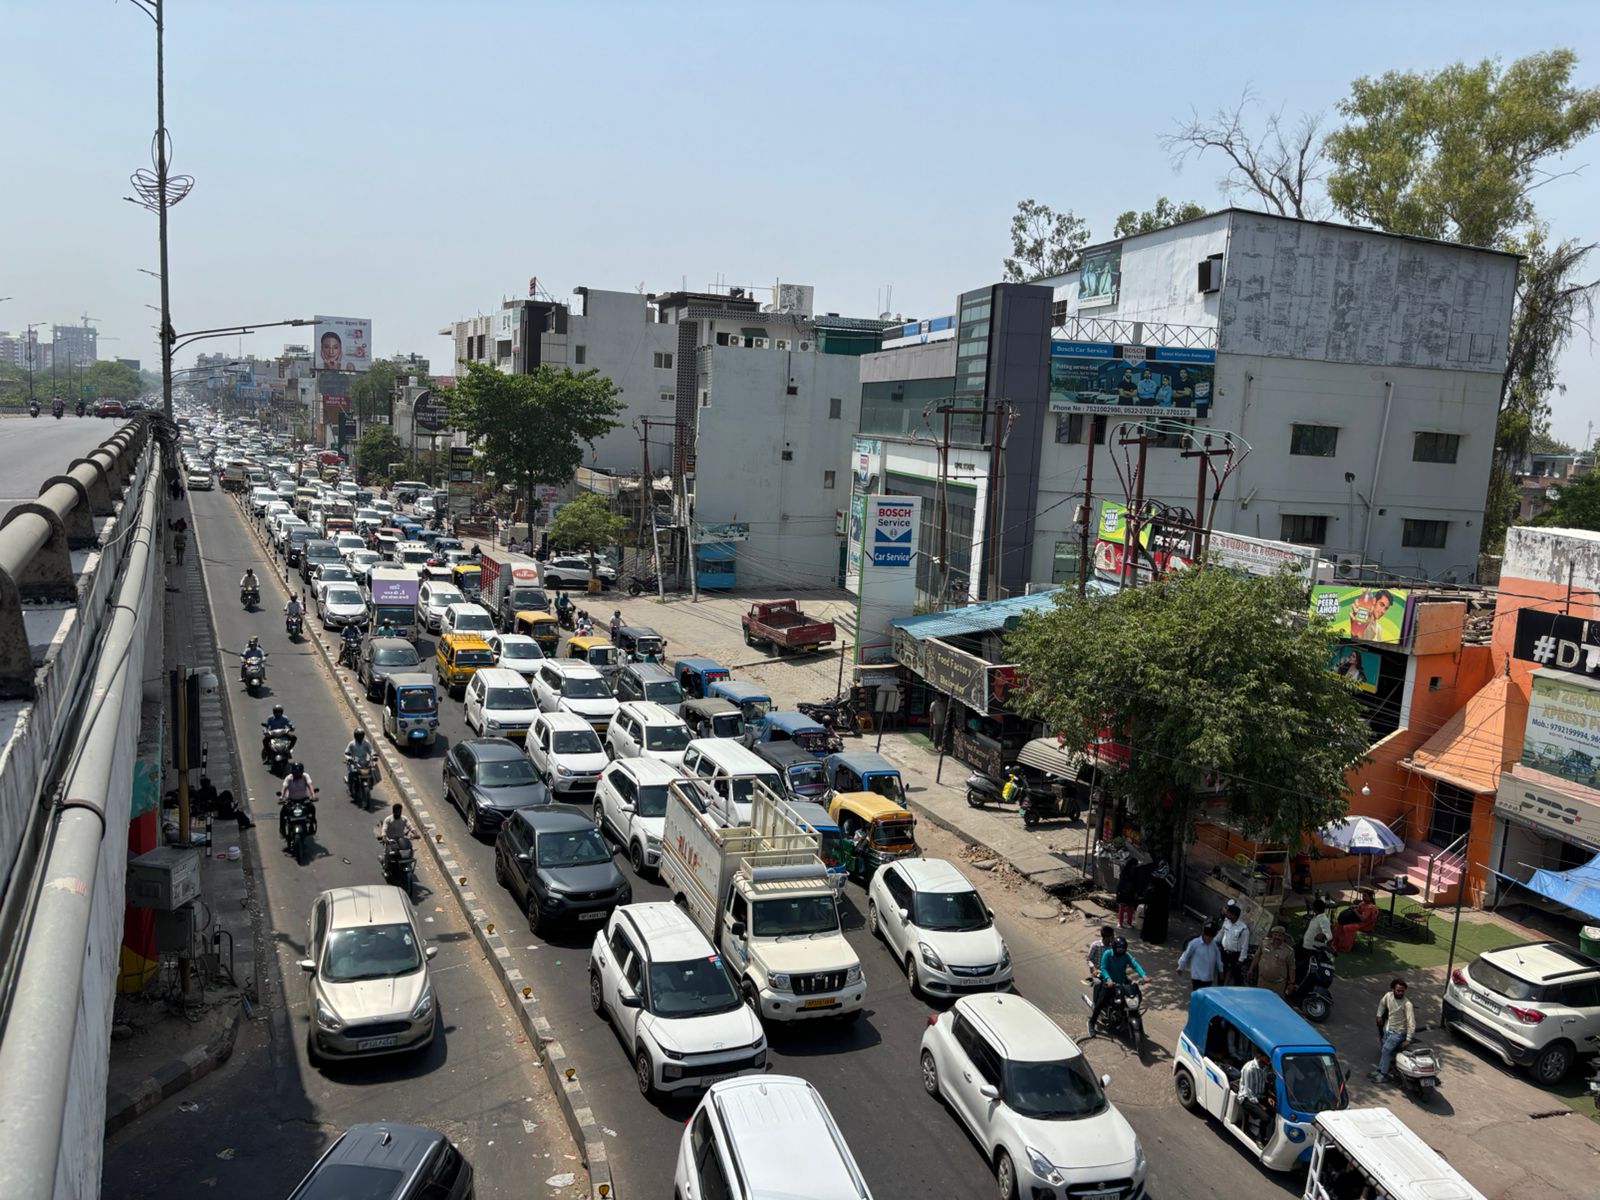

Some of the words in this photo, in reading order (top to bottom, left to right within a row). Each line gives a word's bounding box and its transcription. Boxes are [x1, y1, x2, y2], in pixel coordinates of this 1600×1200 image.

[878, 508, 912, 518] BOSCH
[877, 518, 911, 527] Service
[1220, 538, 1250, 552] STUDIO
[874, 552, 885, 561] Car
[886, 552, 910, 562] Service
[1542, 703, 1587, 728] XPRESS
[1521, 792, 1579, 825] DTDC
